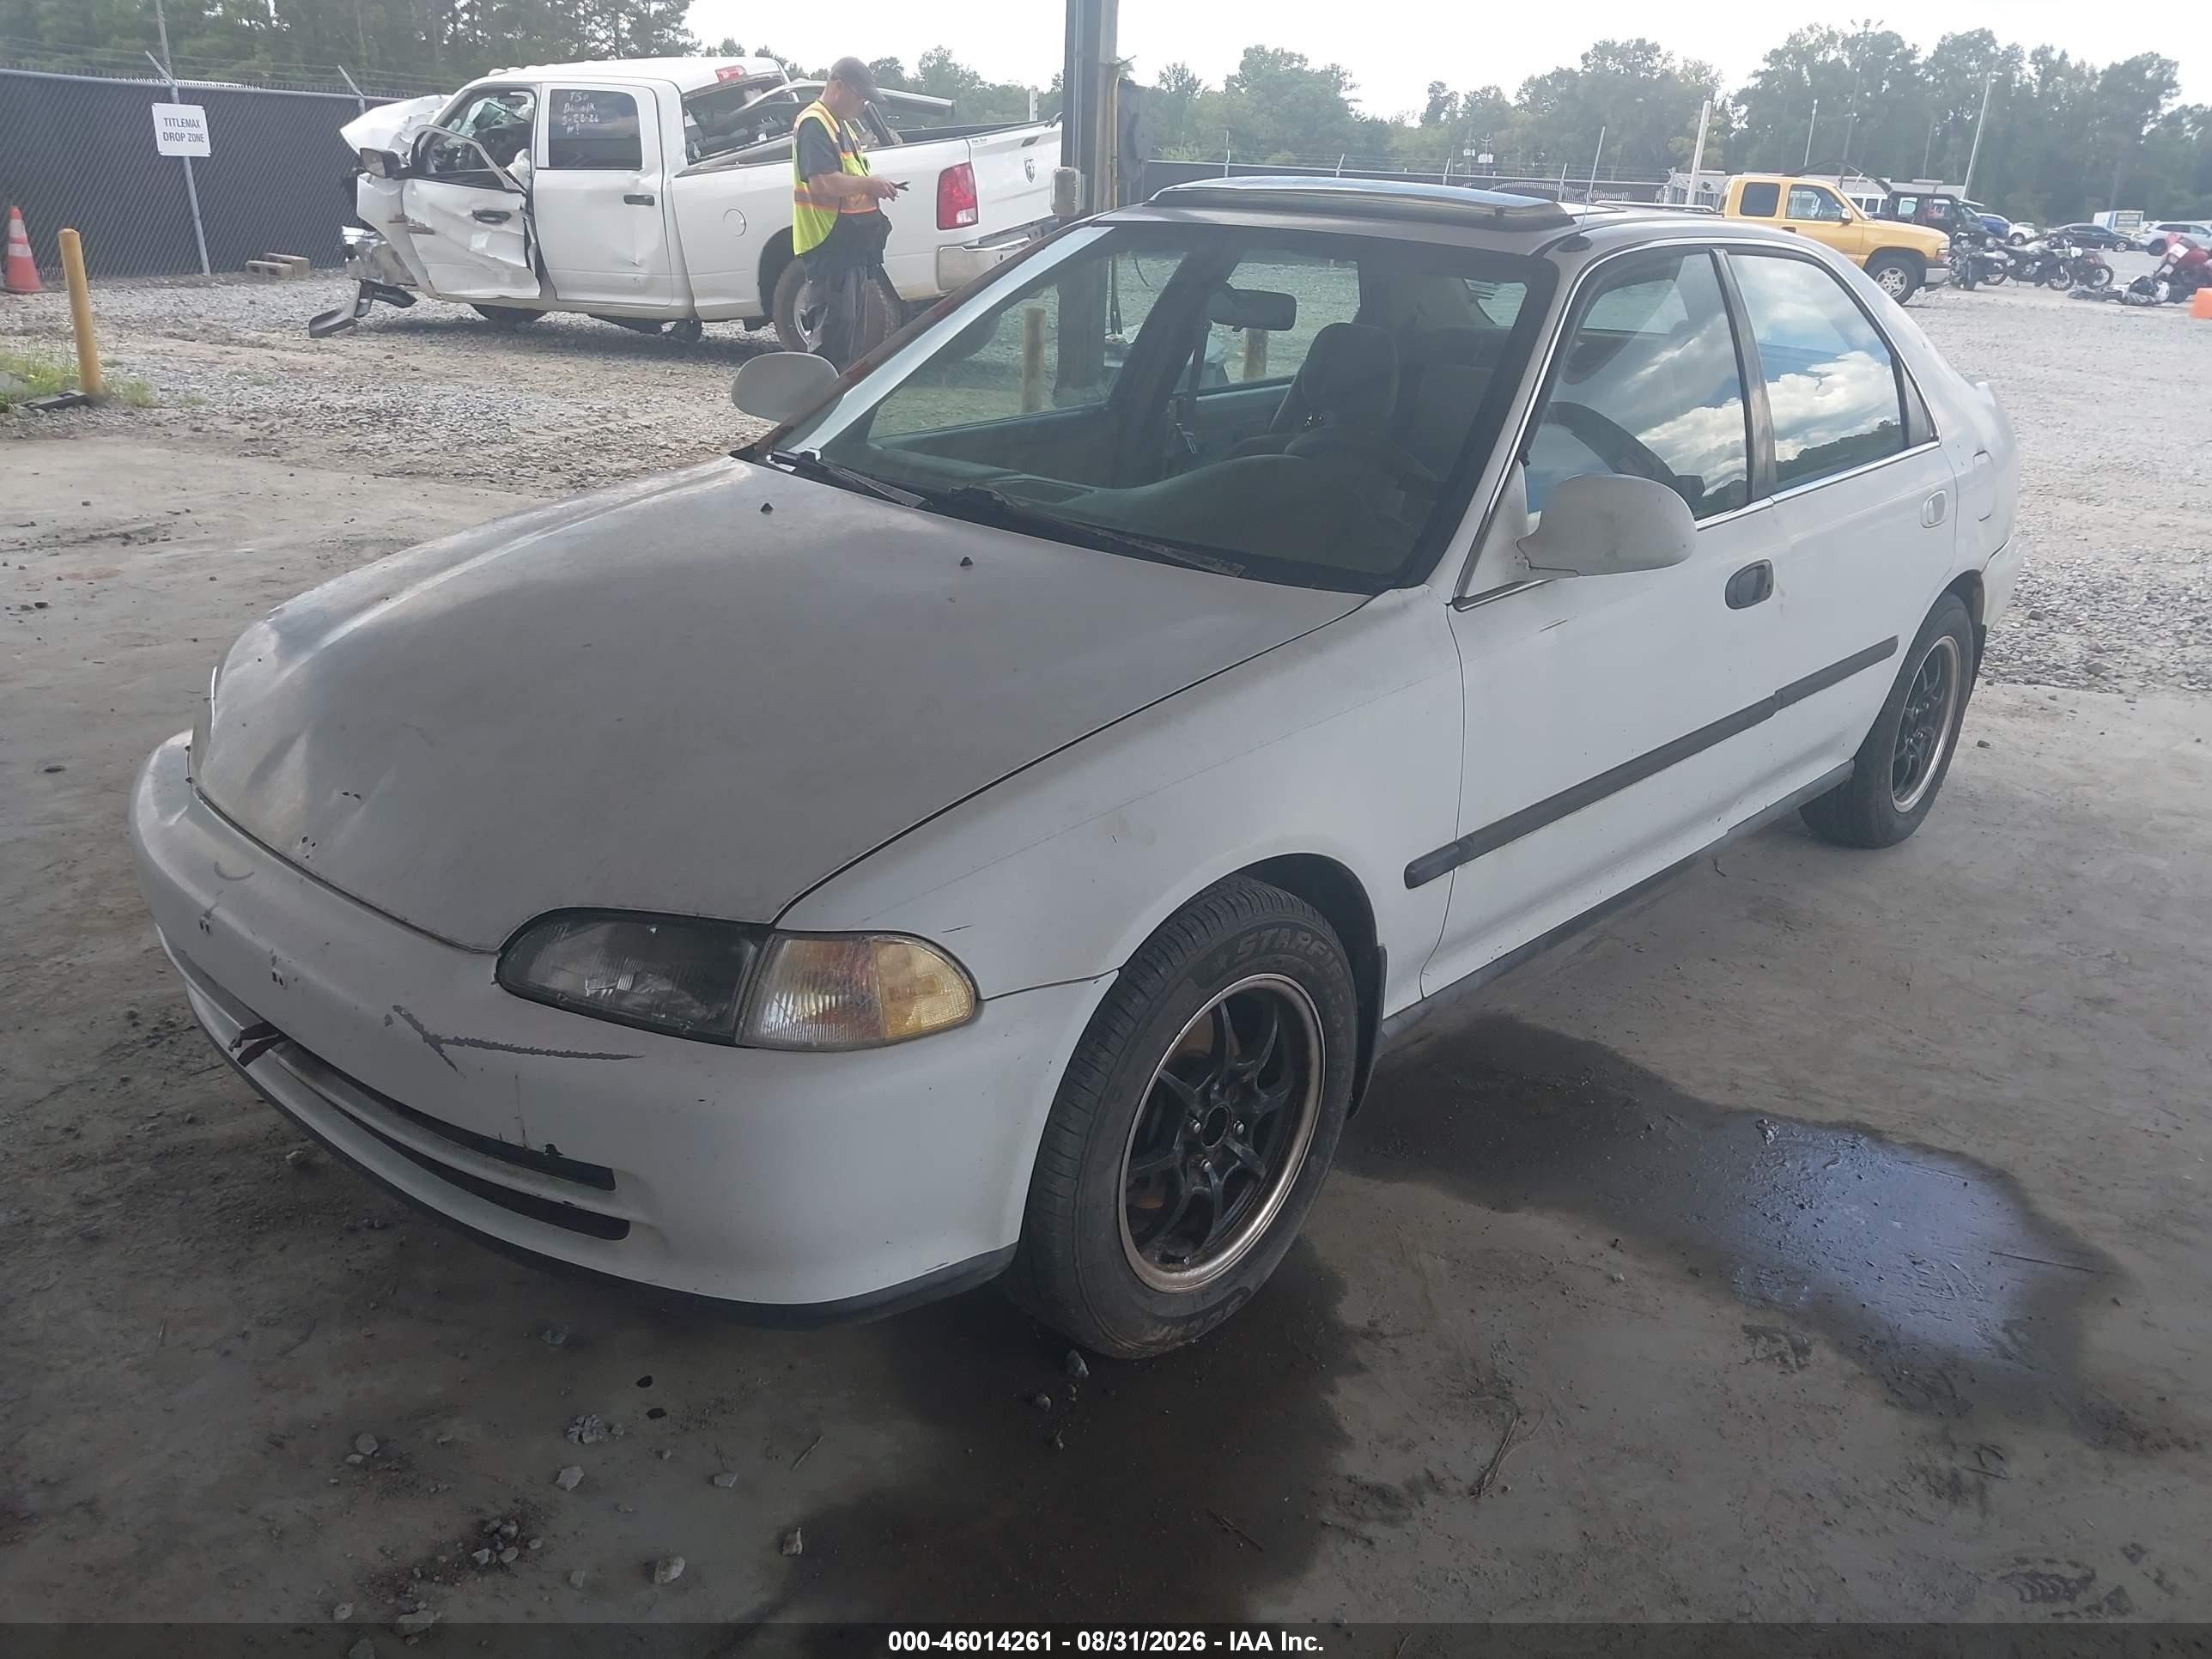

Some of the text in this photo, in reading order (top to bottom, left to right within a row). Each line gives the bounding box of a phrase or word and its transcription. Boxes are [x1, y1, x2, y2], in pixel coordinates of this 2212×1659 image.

[163, 117, 201, 129] TITLEMAX
[162, 131, 205, 143] DROP ZONE
